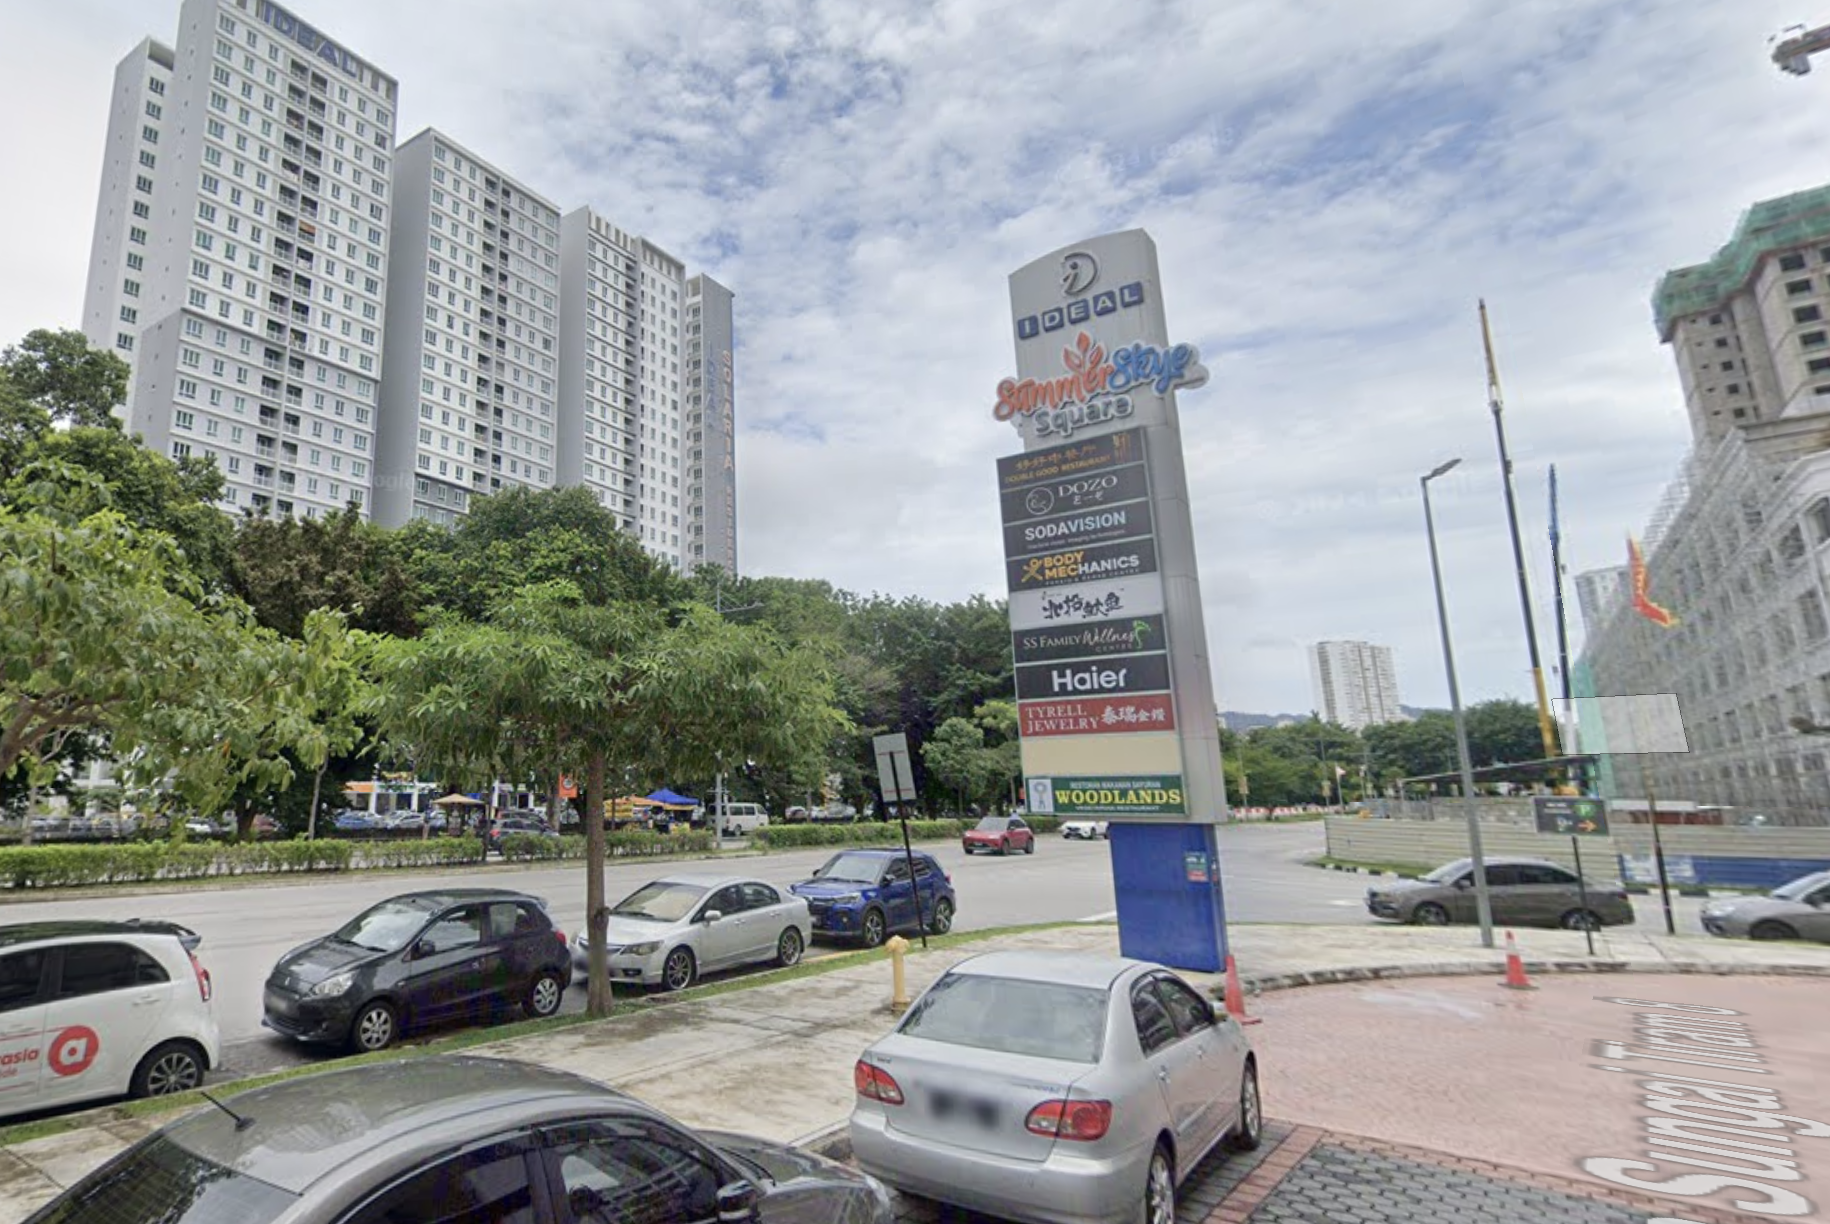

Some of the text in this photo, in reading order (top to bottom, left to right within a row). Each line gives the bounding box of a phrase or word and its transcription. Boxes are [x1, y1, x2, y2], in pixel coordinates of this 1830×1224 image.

[1020, 283, 1142, 337] IDEAL
[1035, 396, 1132, 437] Square
[1058, 475, 1118, 497] DOZO
[1025, 511, 1127, 541] SODAVISION
[1043, 551, 1084, 567] BODY
[1045, 554, 1140, 580] MECHANICS
[1023, 637, 1038, 650] SS
[1039, 634, 1082, 648] FAMILY
[1051, 665, 1127, 692] Haier
[1025, 704, 1087, 719] TYRELL
[1027, 717, 1099, 734] JEWELRY
[1055, 789, 1181, 804] WOODLANDS
